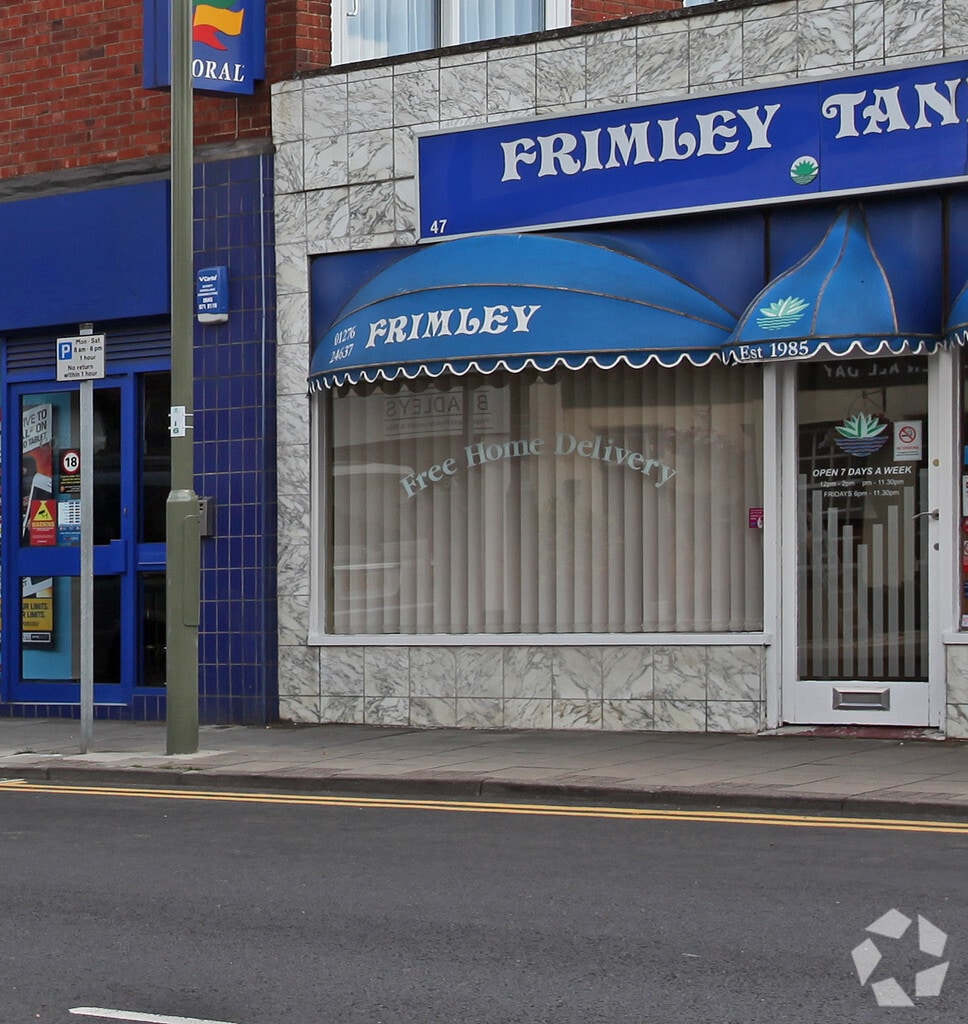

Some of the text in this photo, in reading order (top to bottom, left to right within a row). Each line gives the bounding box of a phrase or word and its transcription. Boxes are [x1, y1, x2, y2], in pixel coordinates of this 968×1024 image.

[191, 59, 244, 82] ORAL
[501, 78, 968, 182] FRIMLEY TAN
[430, 219, 447, 234] 47
[365, 304, 541, 349] FRIMLEY
[334, 325, 357, 346] 01276
[62, 344, 70, 358] P
[739, 340, 809, 360] Est 1985
[37, 409, 47, 421] TO
[36, 421, 47, 433] ON
[65, 457, 78, 468] 18
[399, 432, 678, 499] Free Home Delivery
[812, 466, 912, 477] OPEN 7 DAYS A WEEK
